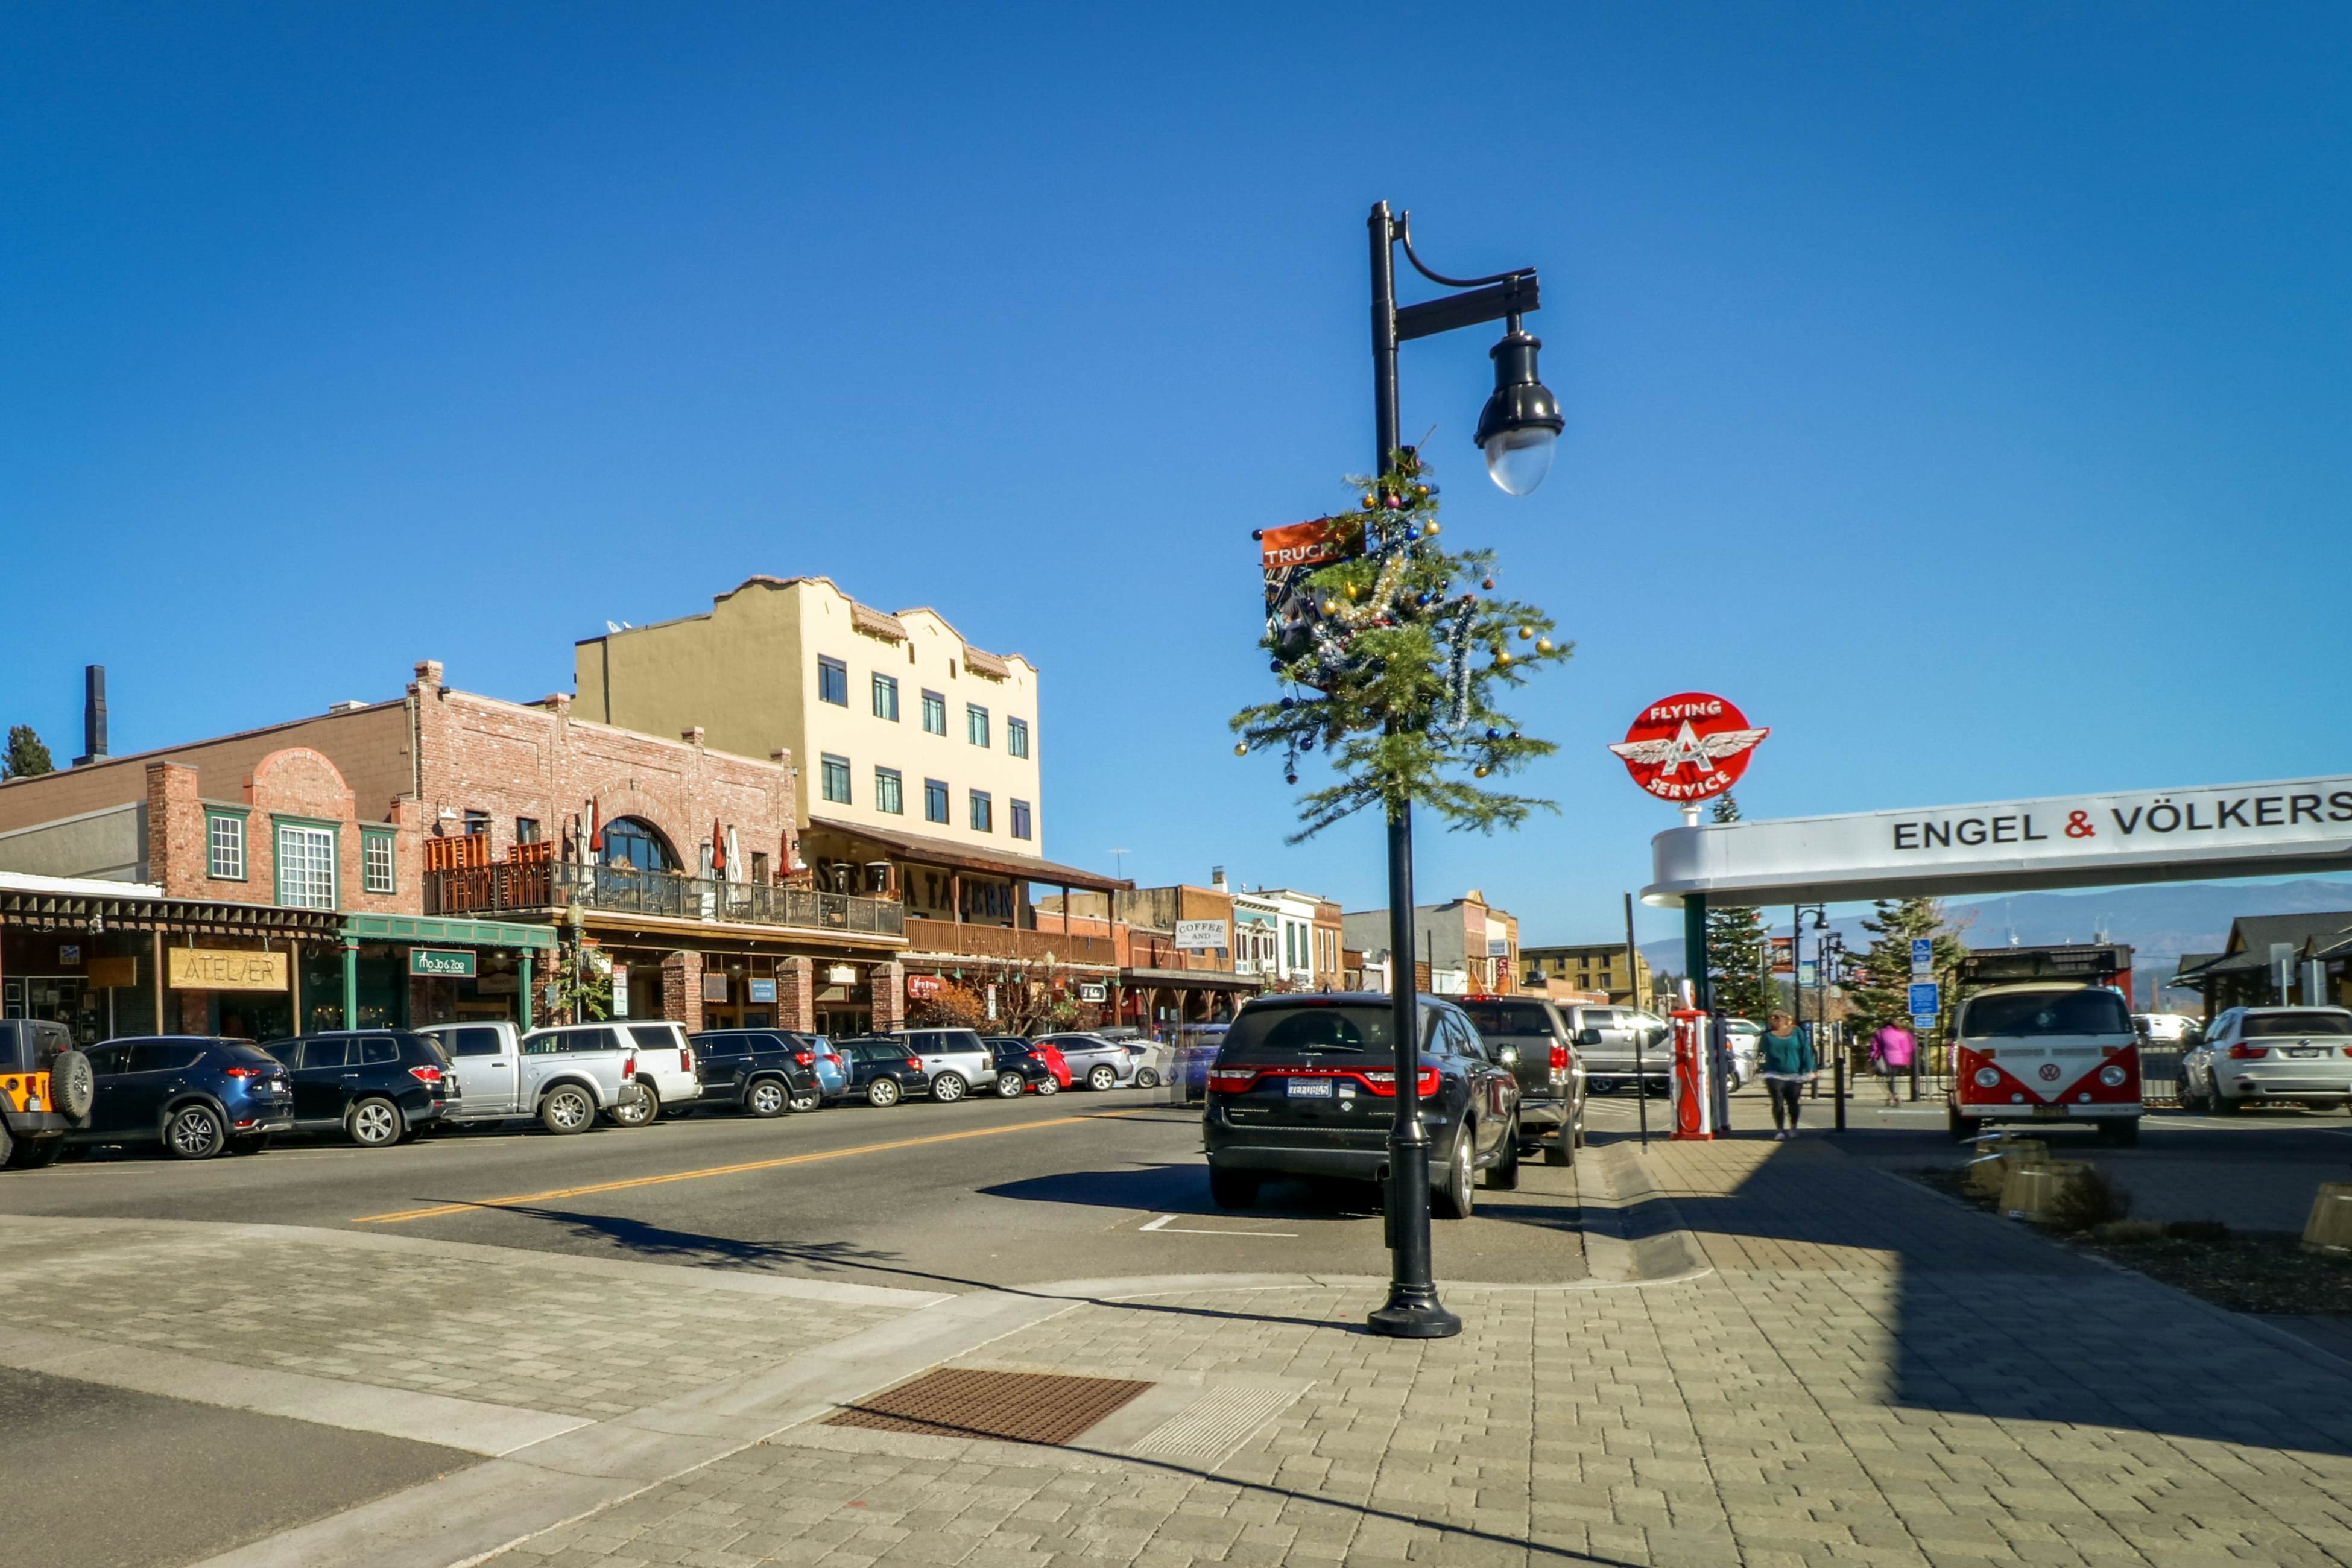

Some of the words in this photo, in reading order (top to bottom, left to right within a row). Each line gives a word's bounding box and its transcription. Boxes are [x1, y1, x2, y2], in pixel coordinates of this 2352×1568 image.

[1650, 700, 1722, 721] FLYING
[1646, 770, 1731, 797] SERVICE
[1893, 814, 2047, 850] ENGEL
[2064, 809, 2096, 839] &
[2111, 791, 2352, 835] VÖLKERS
[1179, 923, 1223, 933] COFFEE
